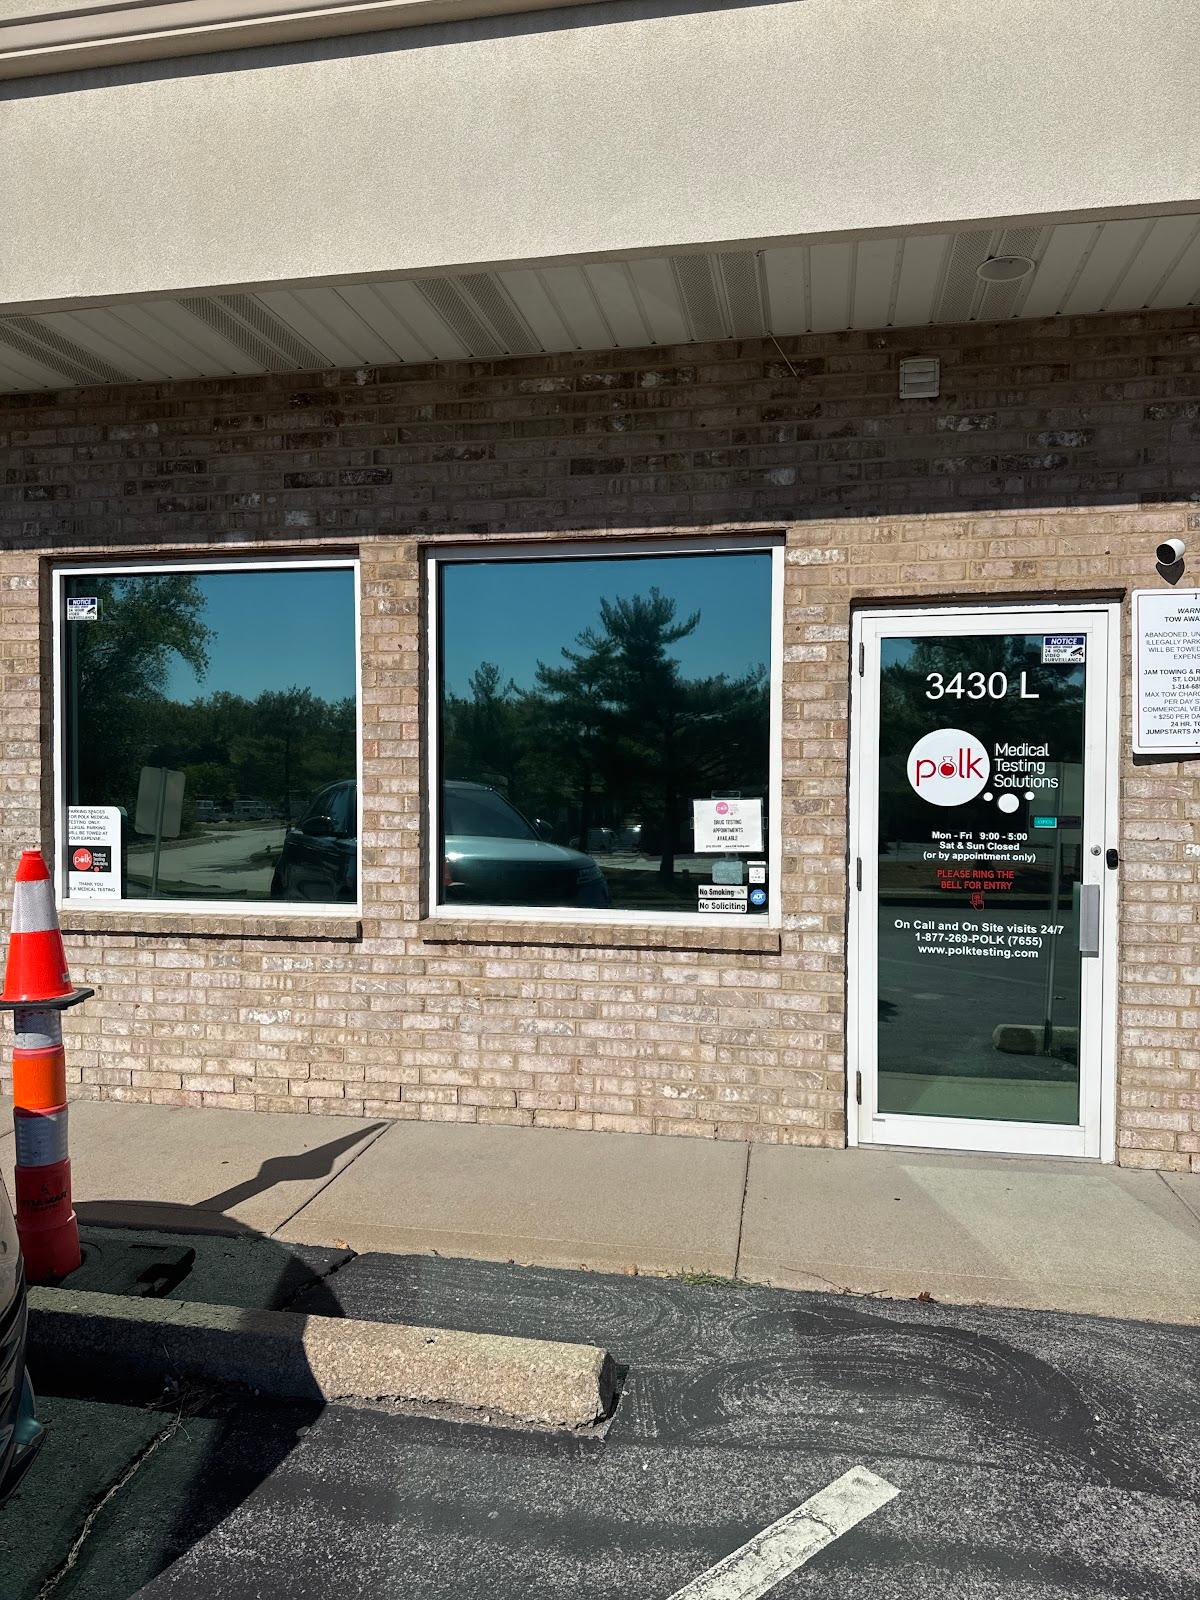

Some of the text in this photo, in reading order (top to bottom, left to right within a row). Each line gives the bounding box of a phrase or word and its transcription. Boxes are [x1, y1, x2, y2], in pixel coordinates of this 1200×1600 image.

[925, 671, 1040, 699] 3430 L
[995, 743, 1050, 756] Medical
[916, 748, 984, 786] polk
[994, 759, 1046, 774] Testing
[994, 775, 1058, 788] Solutions
[932, 831, 951, 840] Mon
[960, 832, 972, 840] Fri
[979, 832, 999, 840] 9:00
[939, 842, 955, 850] Sat
[966, 842, 984, 850] Sun
[987, 842, 1019, 851] Closed
[938, 852, 950, 861] by
[952, 852, 1011, 862] appointment
[1012, 853, 1036, 863] only)
[937, 870, 971, 878] PLEASE
[973, 870, 994, 878] RING
[940, 881, 962, 889] BELL
[984, 882, 1012, 890] ENTRY
[709, 888, 734, 897] Smoking
[711, 902, 745, 911] Soliciting
[894, 920, 1064, 934] On Call and On Site visits 24/7
[915, 933, 1043, 948] 1-877-269-POLK (7655)
[918, 945, 1039, 959] www.polktesting.com
